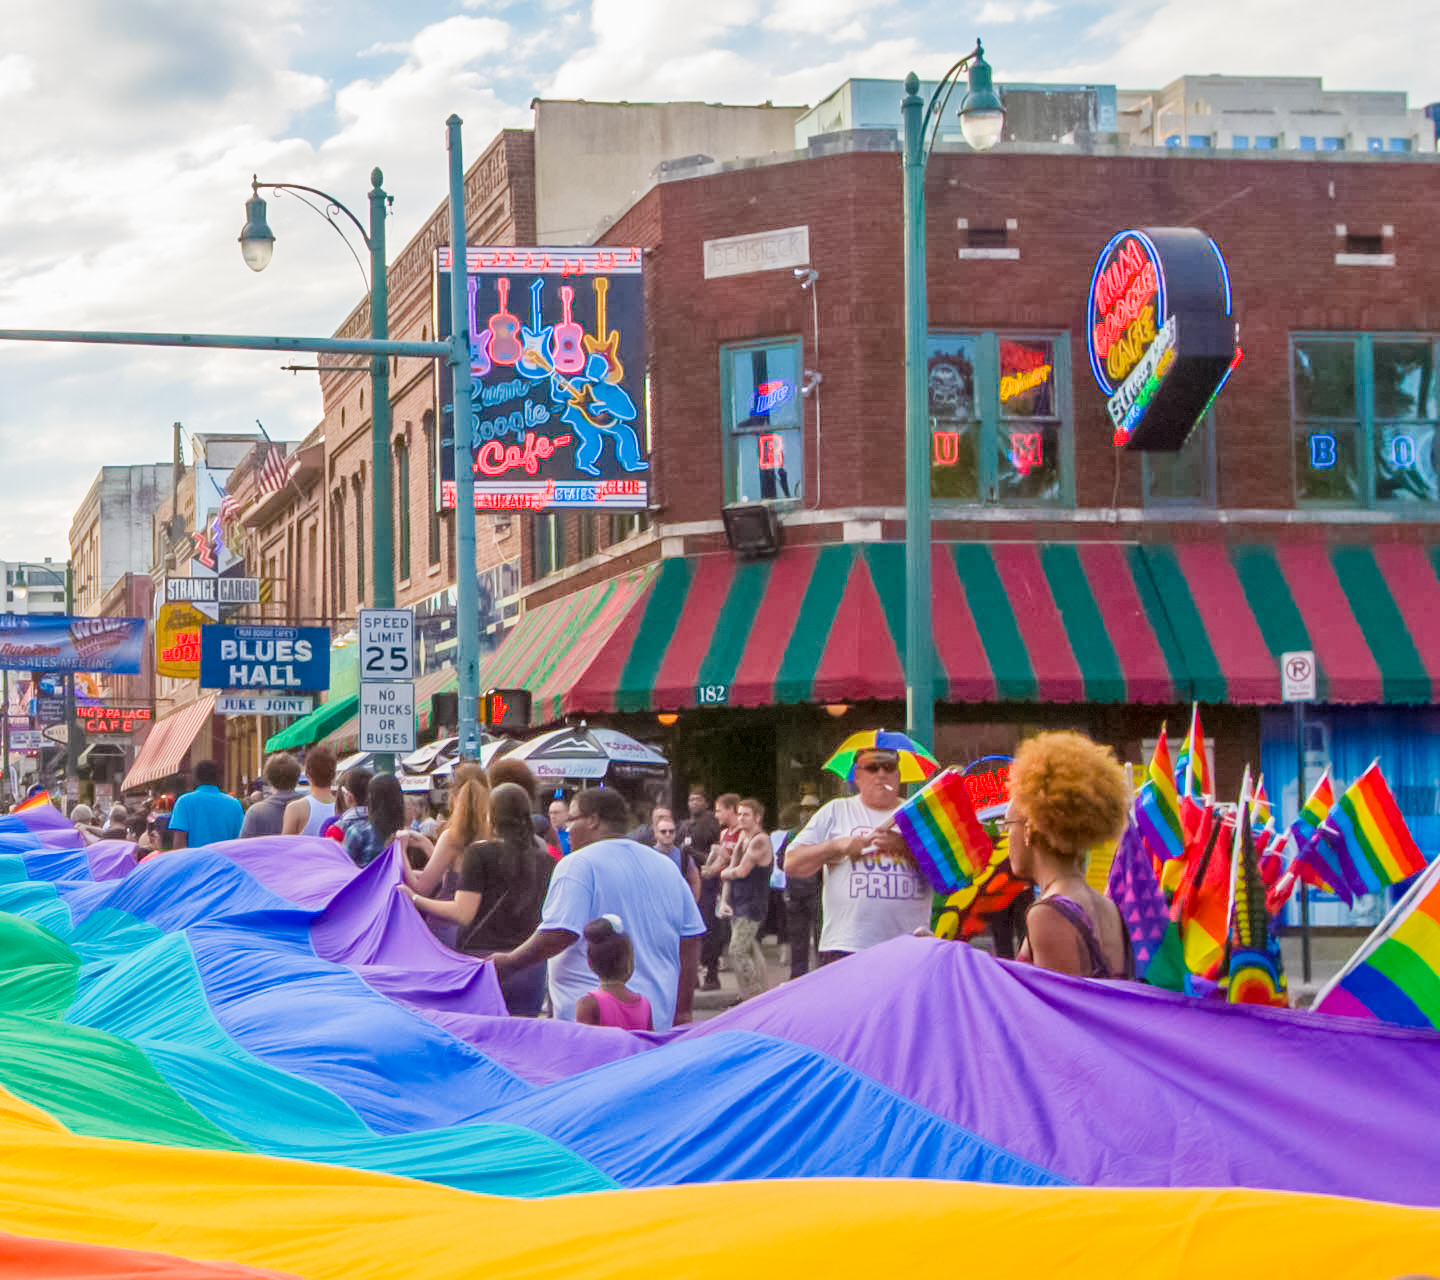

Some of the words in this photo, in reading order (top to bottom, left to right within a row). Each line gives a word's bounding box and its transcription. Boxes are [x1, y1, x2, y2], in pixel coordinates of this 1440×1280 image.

[167, 578, 218, 602] STRANGE
[220, 579, 258, 601] CARGO
[364, 618, 409, 629] SPEED
[368, 631, 404, 643] LIMIT
[220, 639, 313, 662] BLUES
[19, 656, 57, 668] SALES
[366, 646, 409, 672] 25
[229, 665, 302, 687] HALL
[378, 690, 395, 701] NO
[699, 685, 727, 704] 182
[222, 698, 256, 710] JUKE
[264, 699, 305, 712] JOINT
[364, 704, 412, 716] TRUCKS
[76, 706, 103, 719] ING'S
[106, 708, 152, 720] PALACE
[86, 720, 133, 733] CAFE
[379, 719, 396, 730] OR
[366, 733, 408, 745] BUSES
[849, 872, 926, 900] PRIDE
